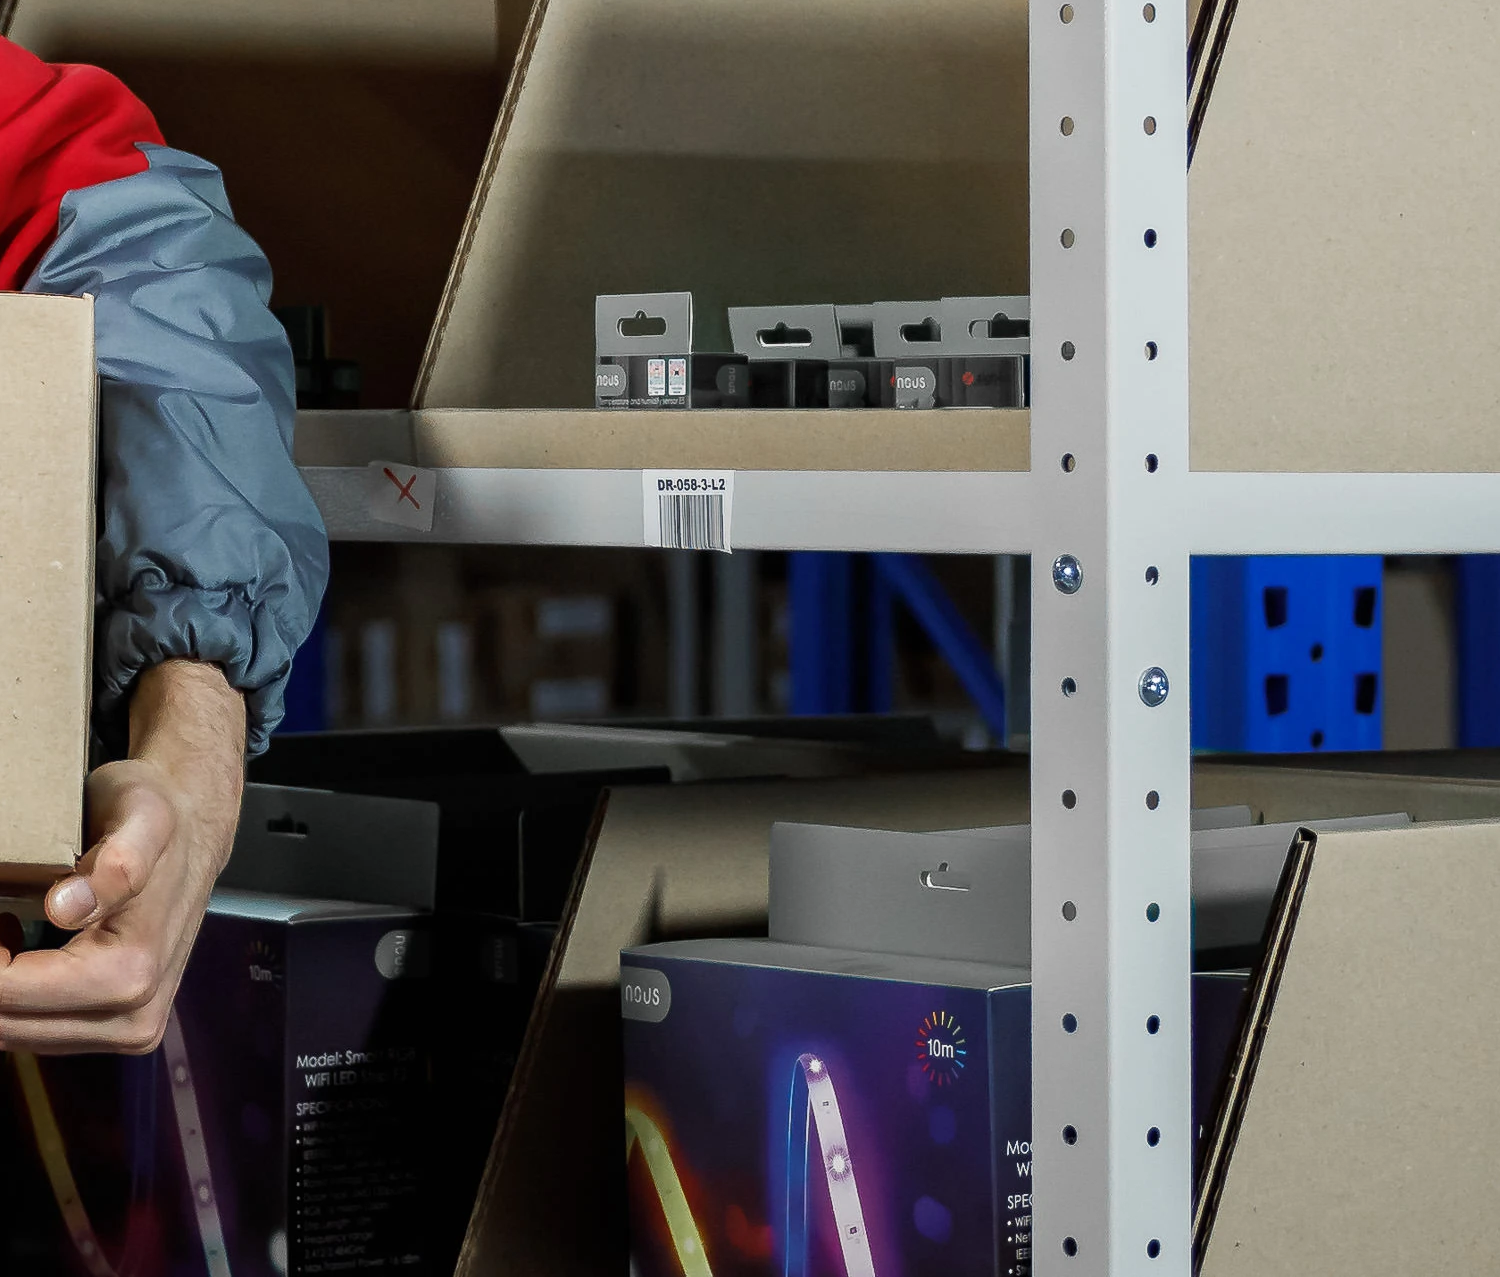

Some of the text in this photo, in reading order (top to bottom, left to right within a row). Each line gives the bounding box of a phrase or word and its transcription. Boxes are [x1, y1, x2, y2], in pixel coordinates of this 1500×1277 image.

[897, 376, 927, 390] nous
[657, 477, 726, 491] DR-058-3-L2
[248, 964, 273, 982] 10m
[625, 984, 661, 1007] nous
[927, 1038, 954, 1059] 10m
[296, 1050, 342, 1069] Model:
[304, 1071, 331, 1089] WiFi
[333, 1069, 358, 1087] LED
[1006, 1140, 1033, 1156] Mo
